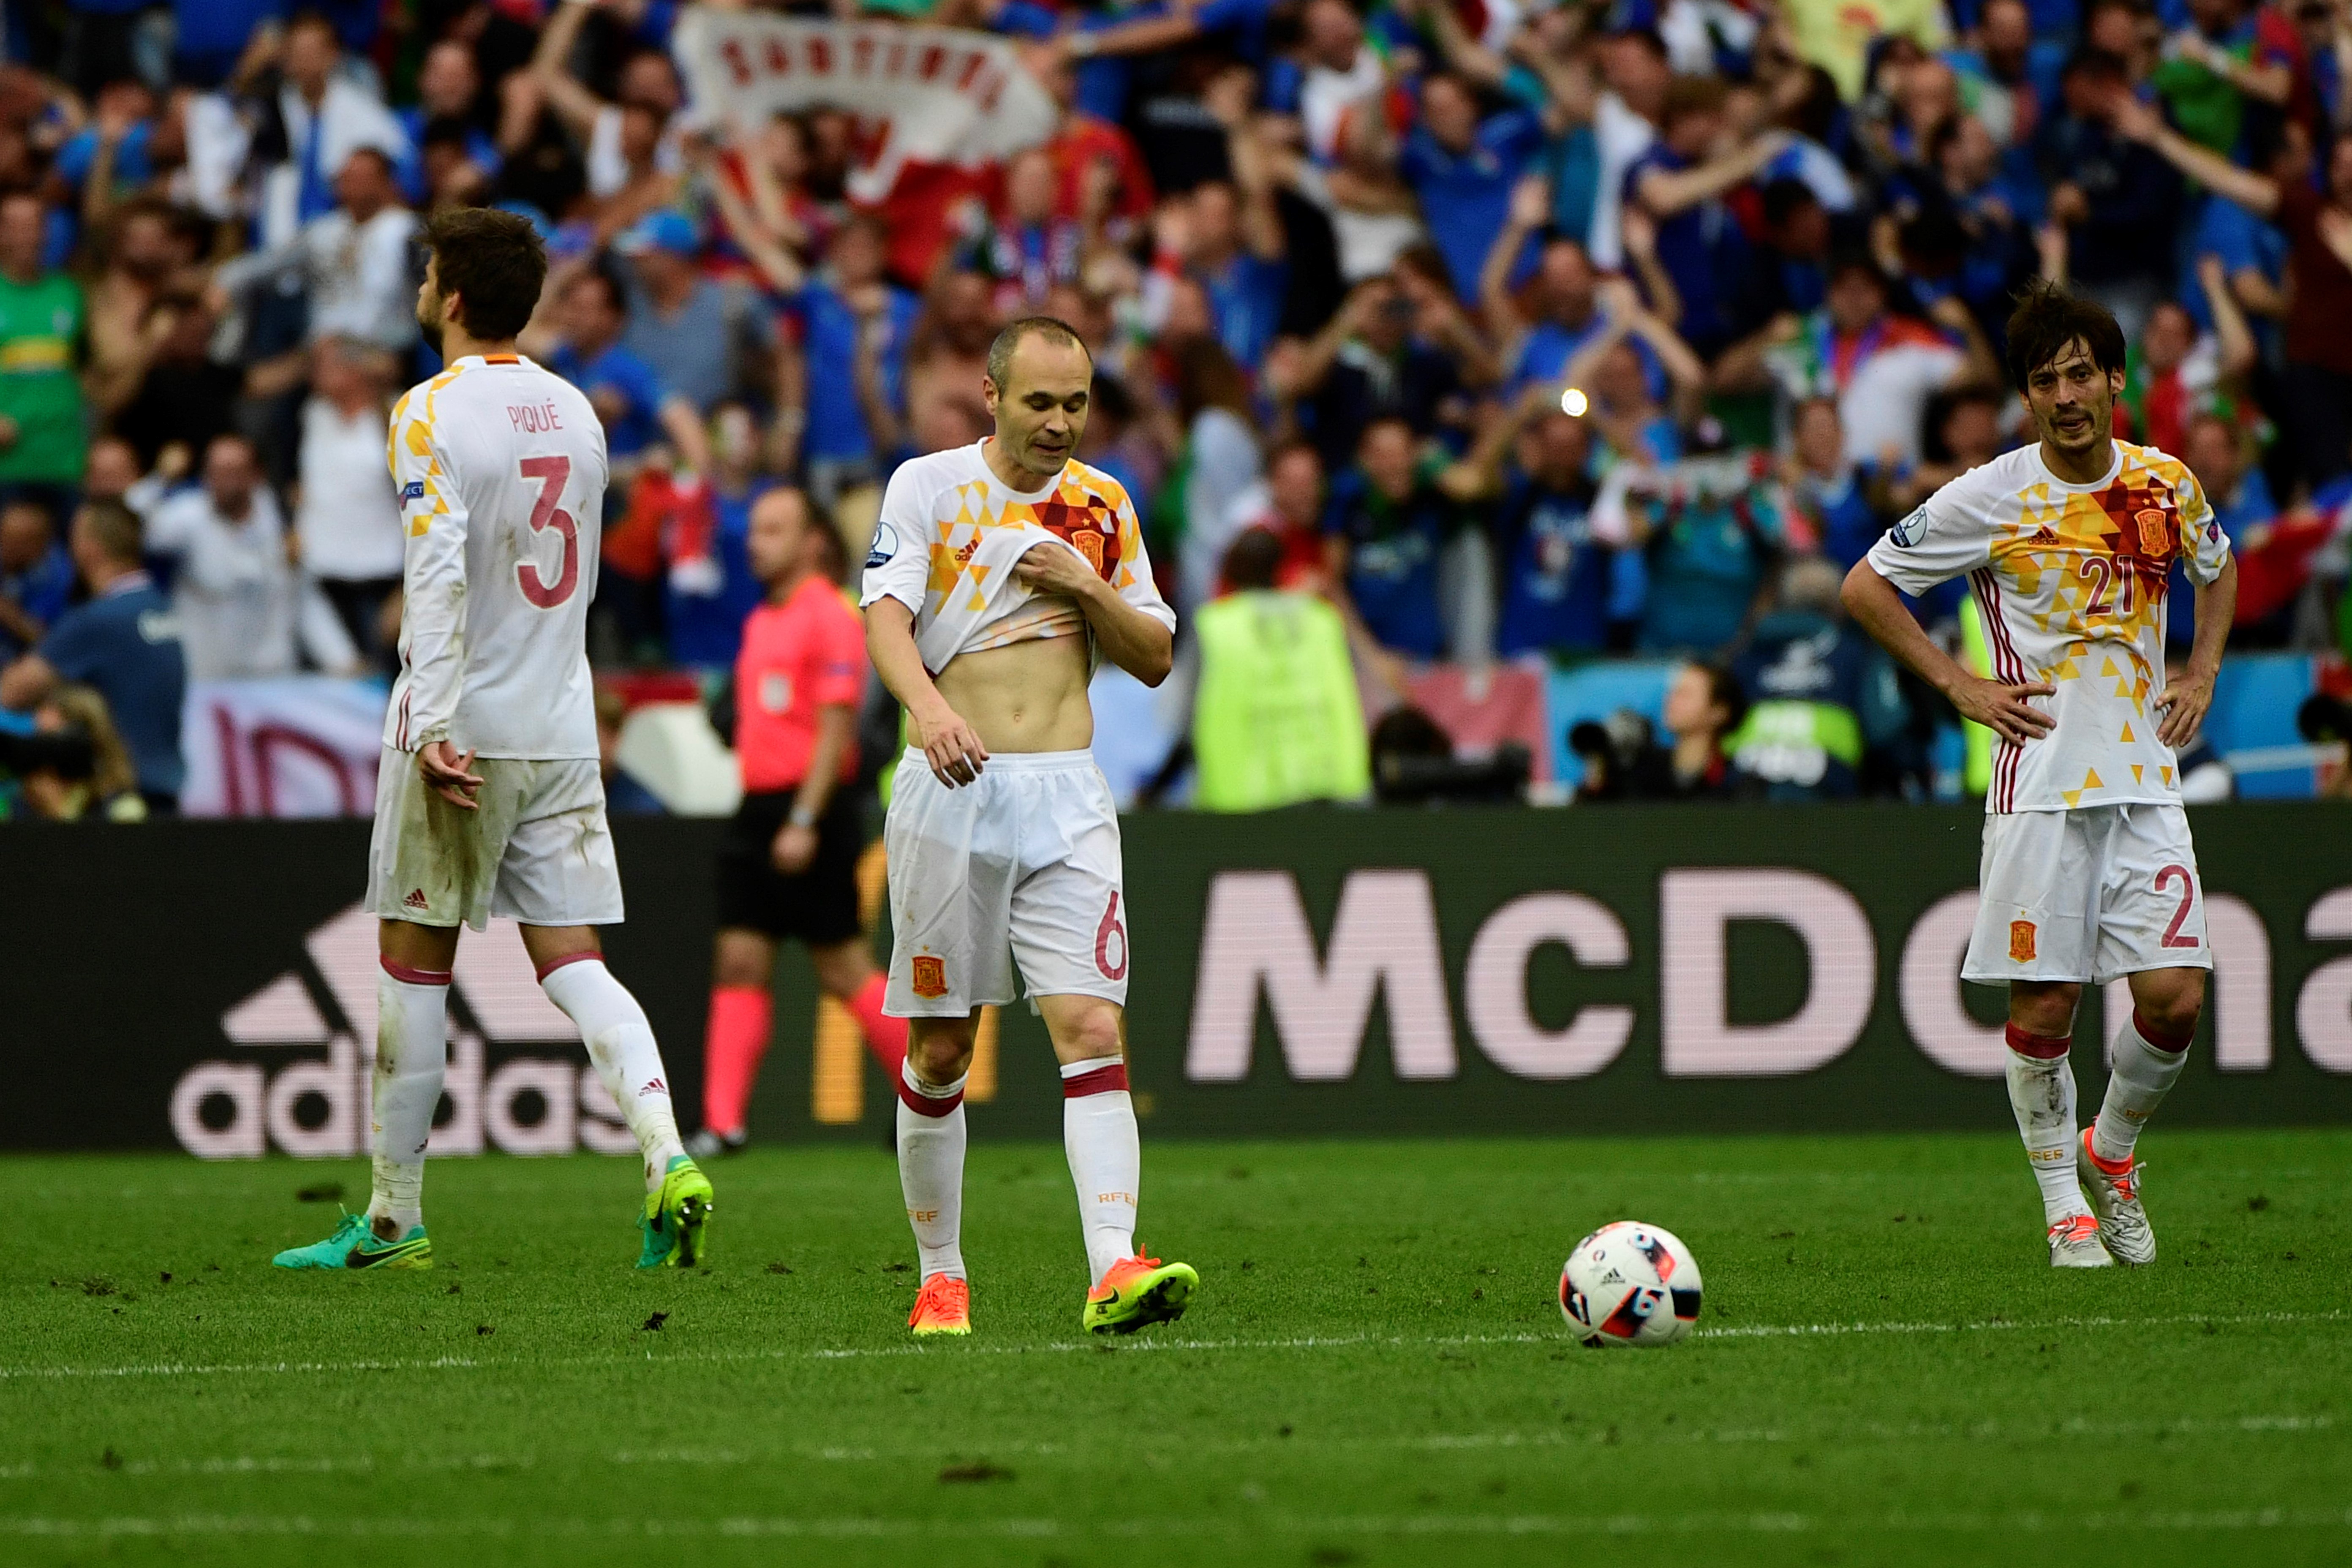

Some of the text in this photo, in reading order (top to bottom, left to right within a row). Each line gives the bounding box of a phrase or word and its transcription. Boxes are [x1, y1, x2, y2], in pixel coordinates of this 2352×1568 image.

[506, 397, 564, 433] PIQUÉ
[515, 455, 579, 610] 3
[2080, 555, 2134, 617] 21
[1094, 889, 1127, 982] 6
[2154, 863, 2208, 948] 2
[171, 1033, 638, 1158] addas
